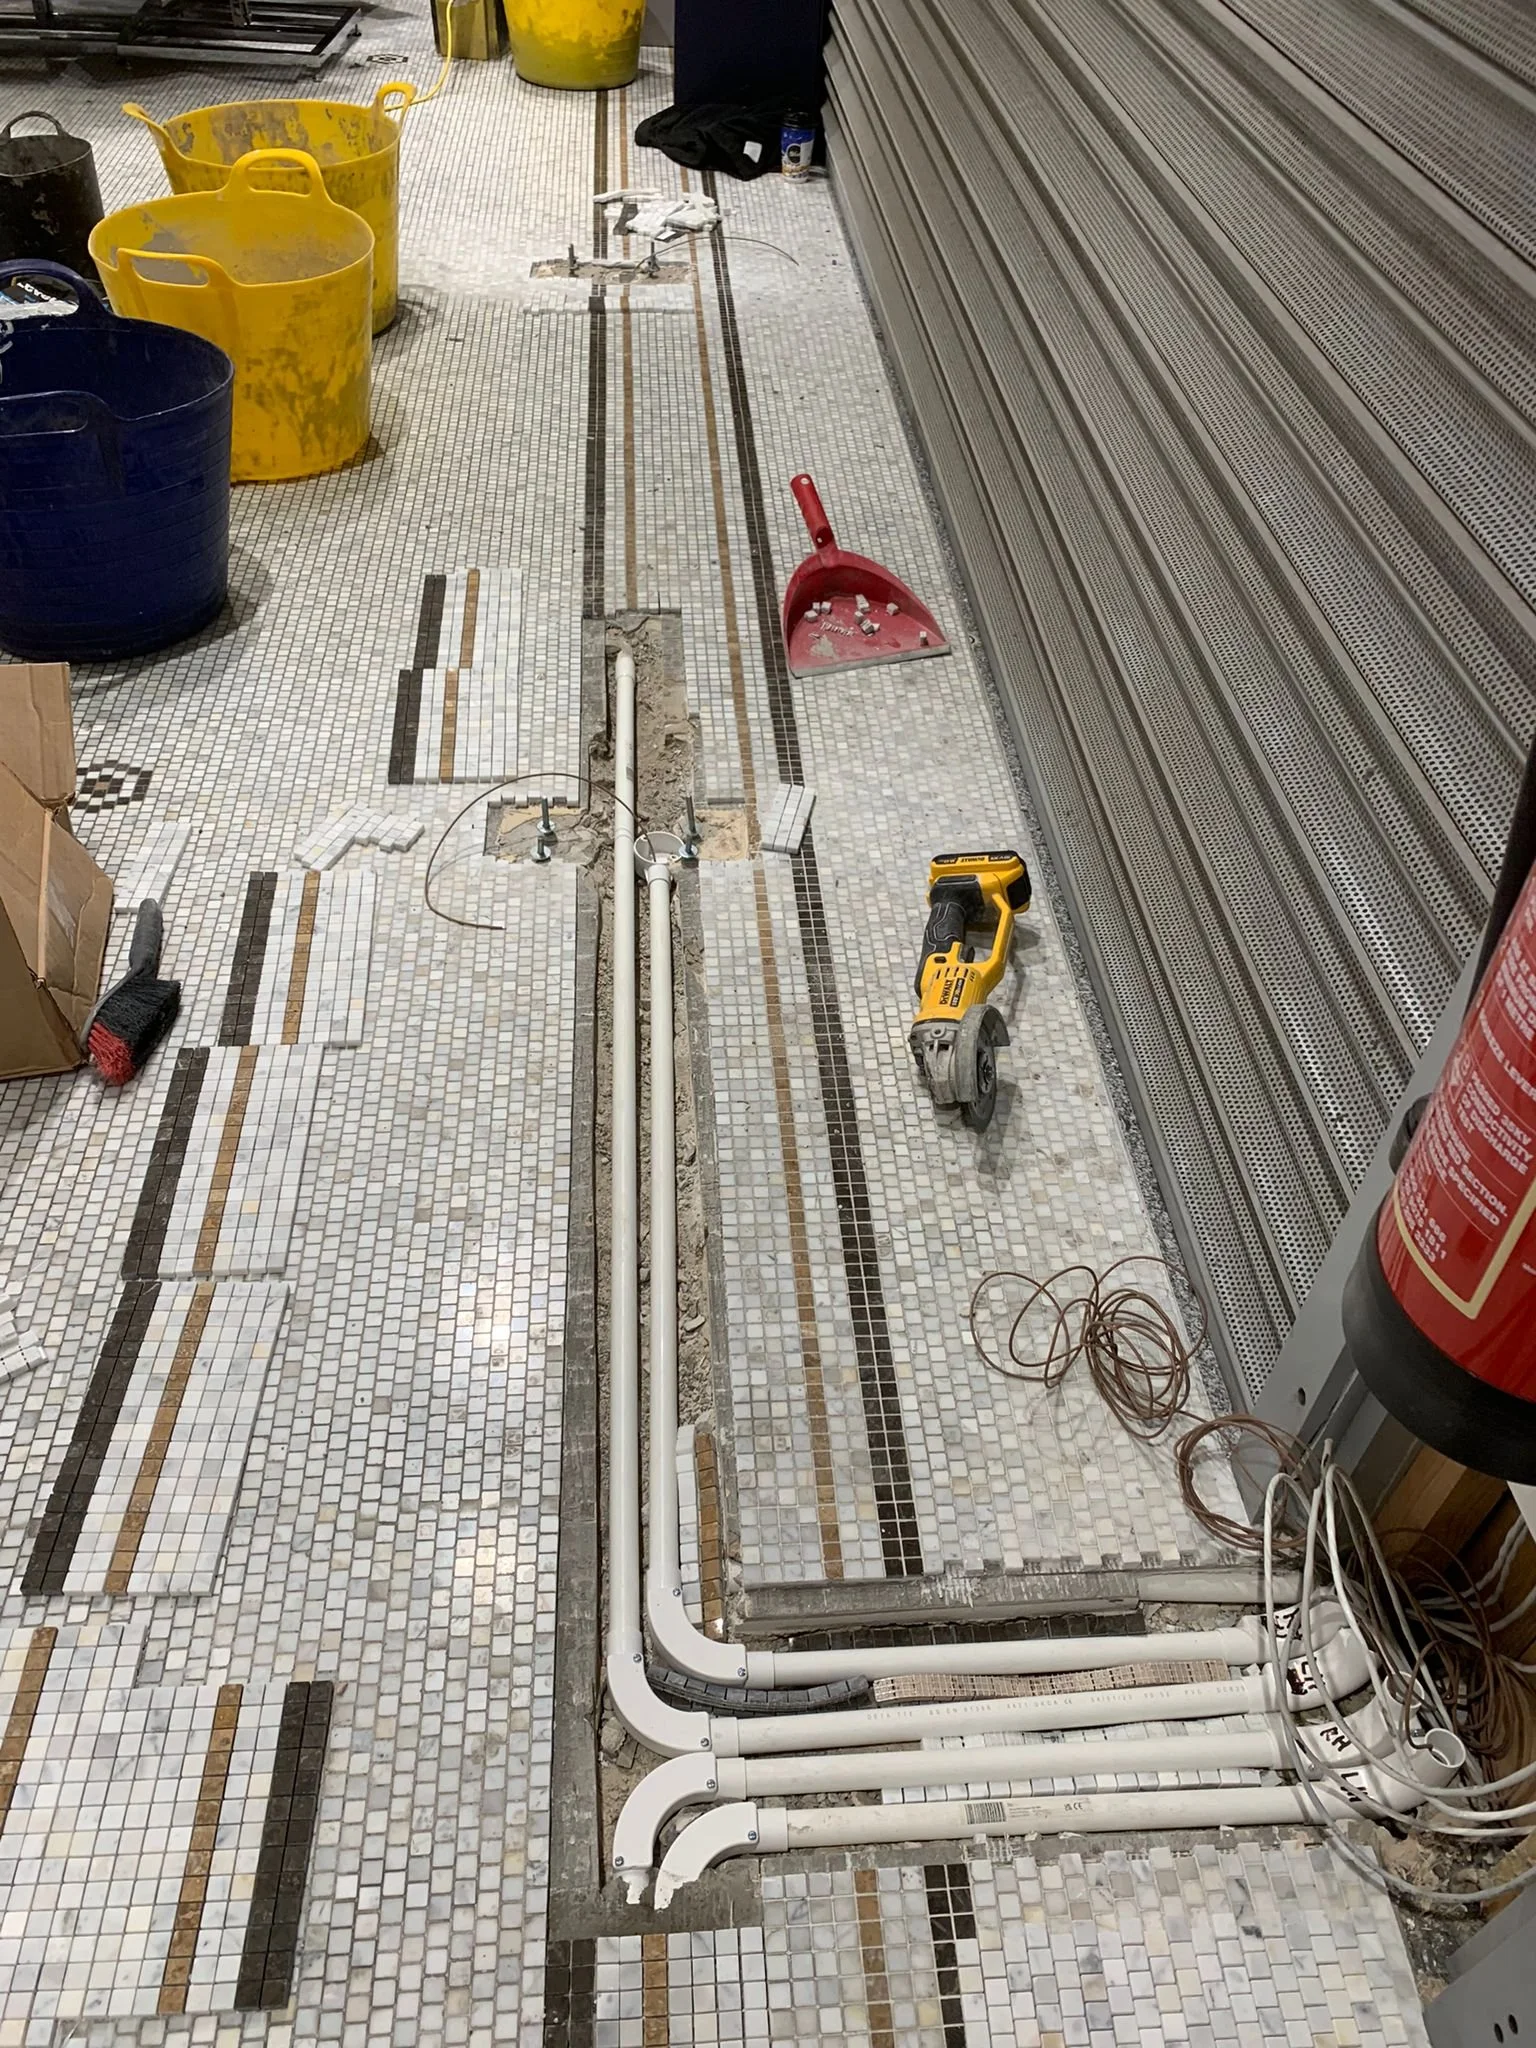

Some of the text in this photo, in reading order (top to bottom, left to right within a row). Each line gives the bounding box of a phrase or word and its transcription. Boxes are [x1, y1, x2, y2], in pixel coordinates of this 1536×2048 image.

[1466, 1082, 1534, 1162] CONDUCTIVITY
[1470, 1109, 1528, 1175] DISCHARGE
[1448, 1166, 1499, 1226] SPECIFIED
